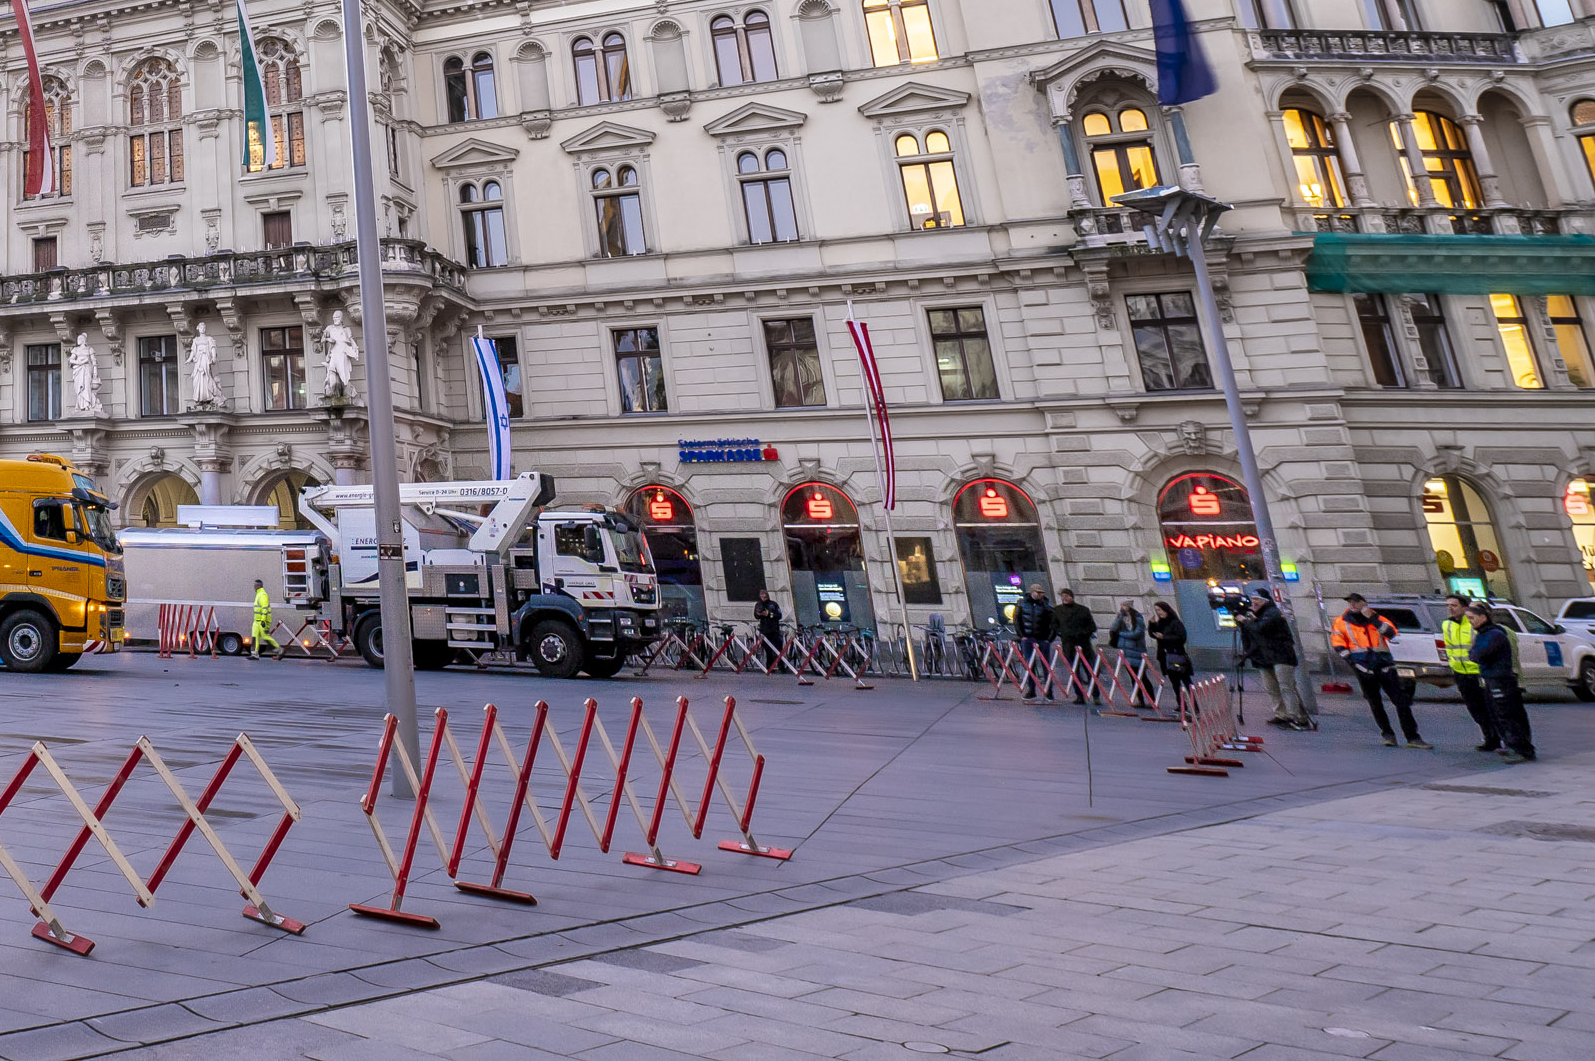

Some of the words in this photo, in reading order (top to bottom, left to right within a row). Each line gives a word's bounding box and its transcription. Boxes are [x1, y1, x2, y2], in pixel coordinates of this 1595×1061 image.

[679, 449, 761, 462] SPARKASSE
[335, 492, 374, 500] www.energie-gr
[460, 487, 508, 496] 0316/8057-0
